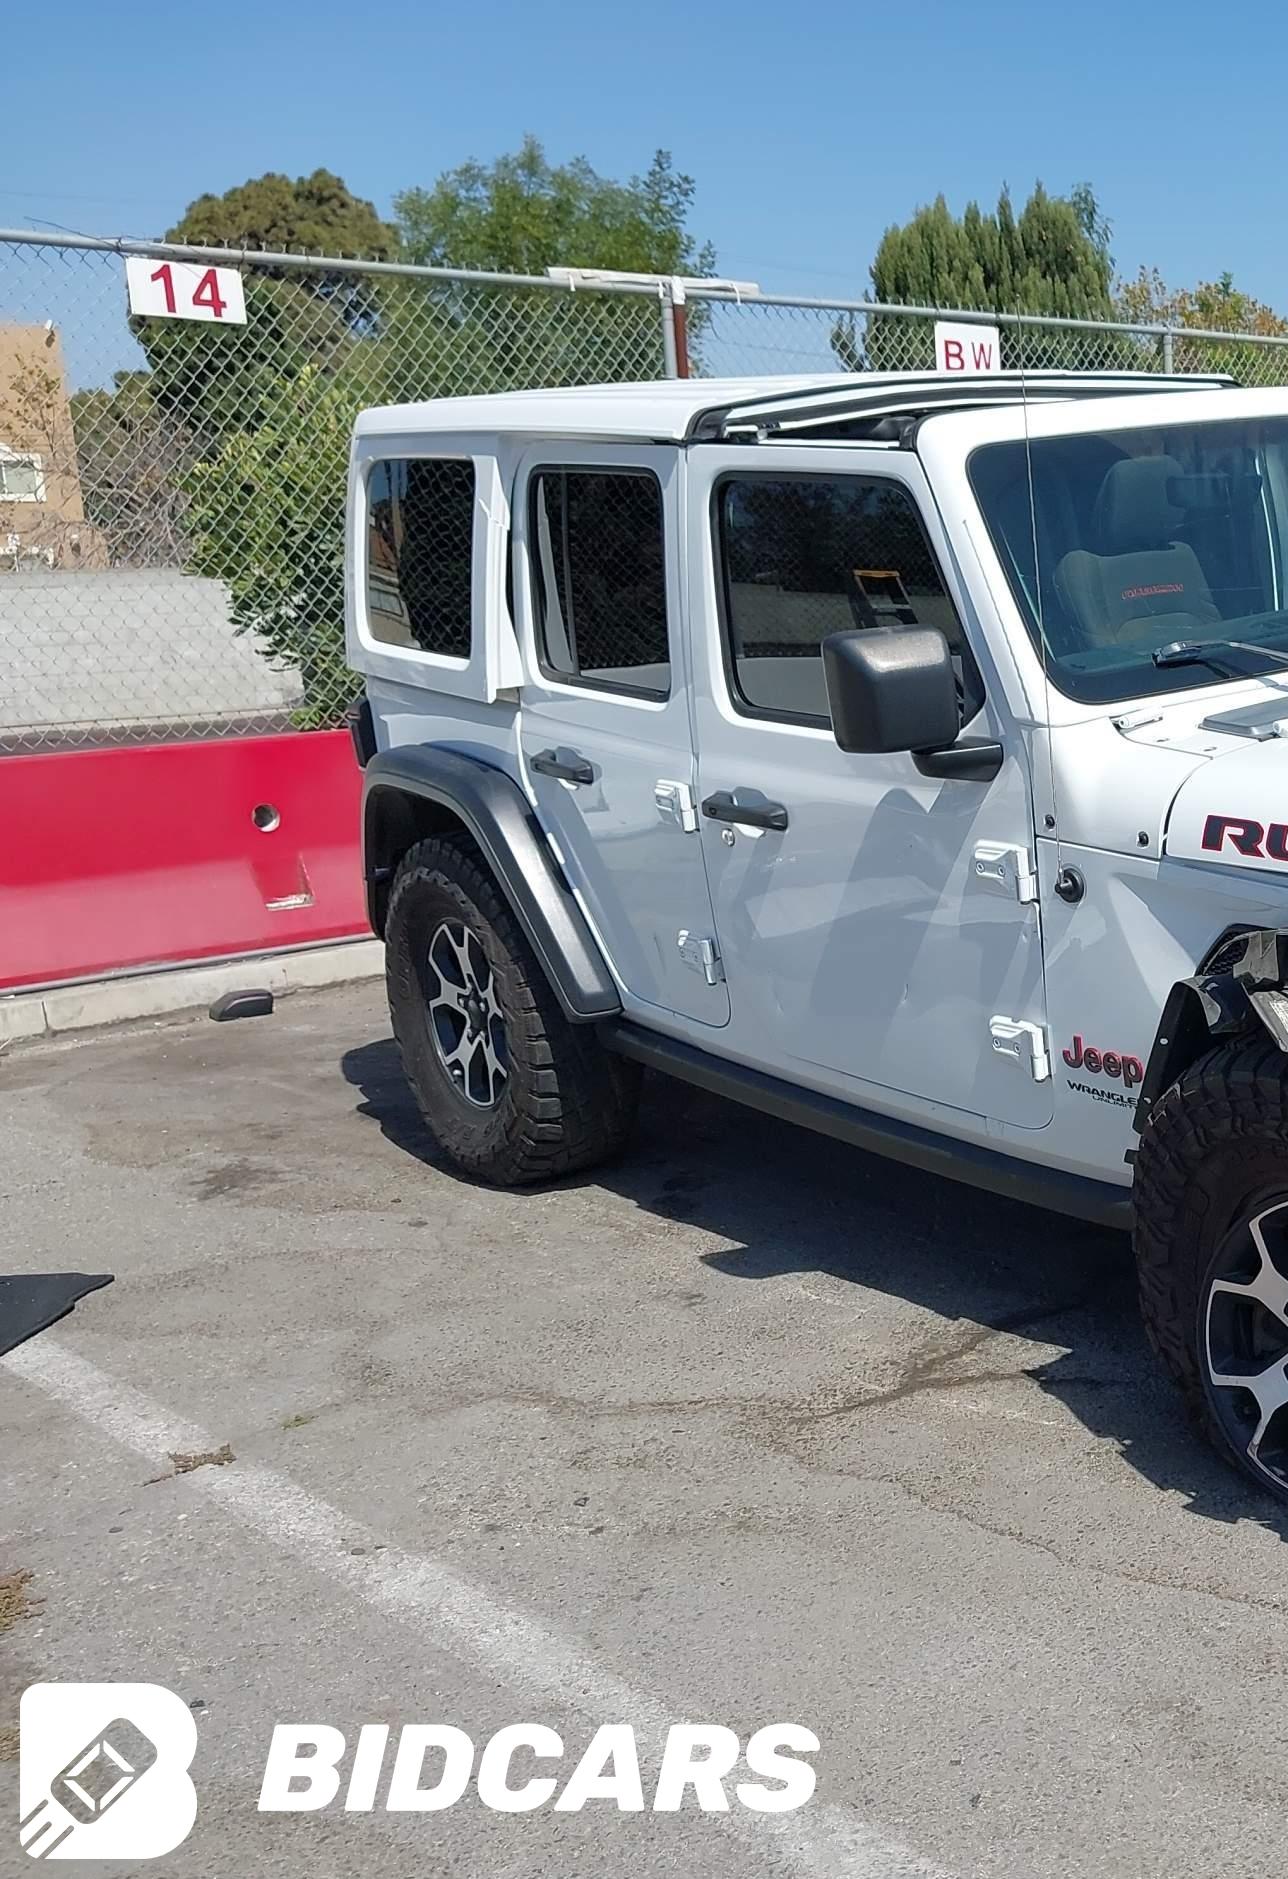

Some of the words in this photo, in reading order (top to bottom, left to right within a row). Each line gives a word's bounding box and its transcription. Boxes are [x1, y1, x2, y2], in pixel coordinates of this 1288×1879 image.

[151, 264, 227, 317] 14
[1062, 1035, 1144, 1088] Jeep
[1067, 1079, 1138, 1106] WRANGLE
